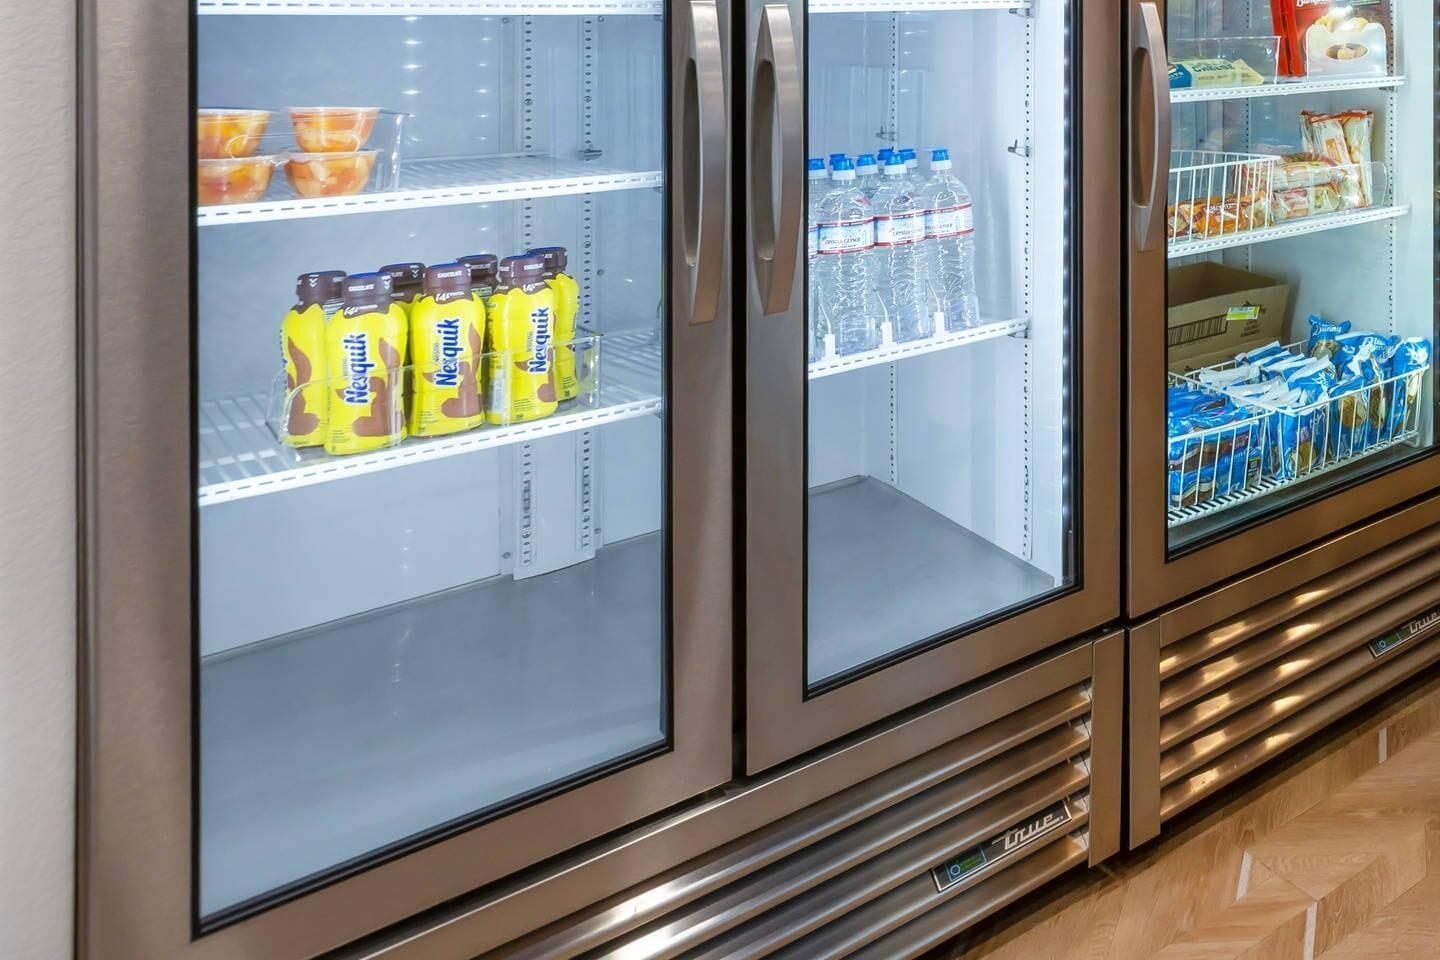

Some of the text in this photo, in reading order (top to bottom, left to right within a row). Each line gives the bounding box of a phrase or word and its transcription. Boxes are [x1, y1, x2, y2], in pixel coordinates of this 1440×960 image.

[344, 333, 375, 404] Nesquik
[435, 318, 464, 386] Nesquik
[529, 306, 551, 373] Nesquik
[992, 813, 1065, 851] true
